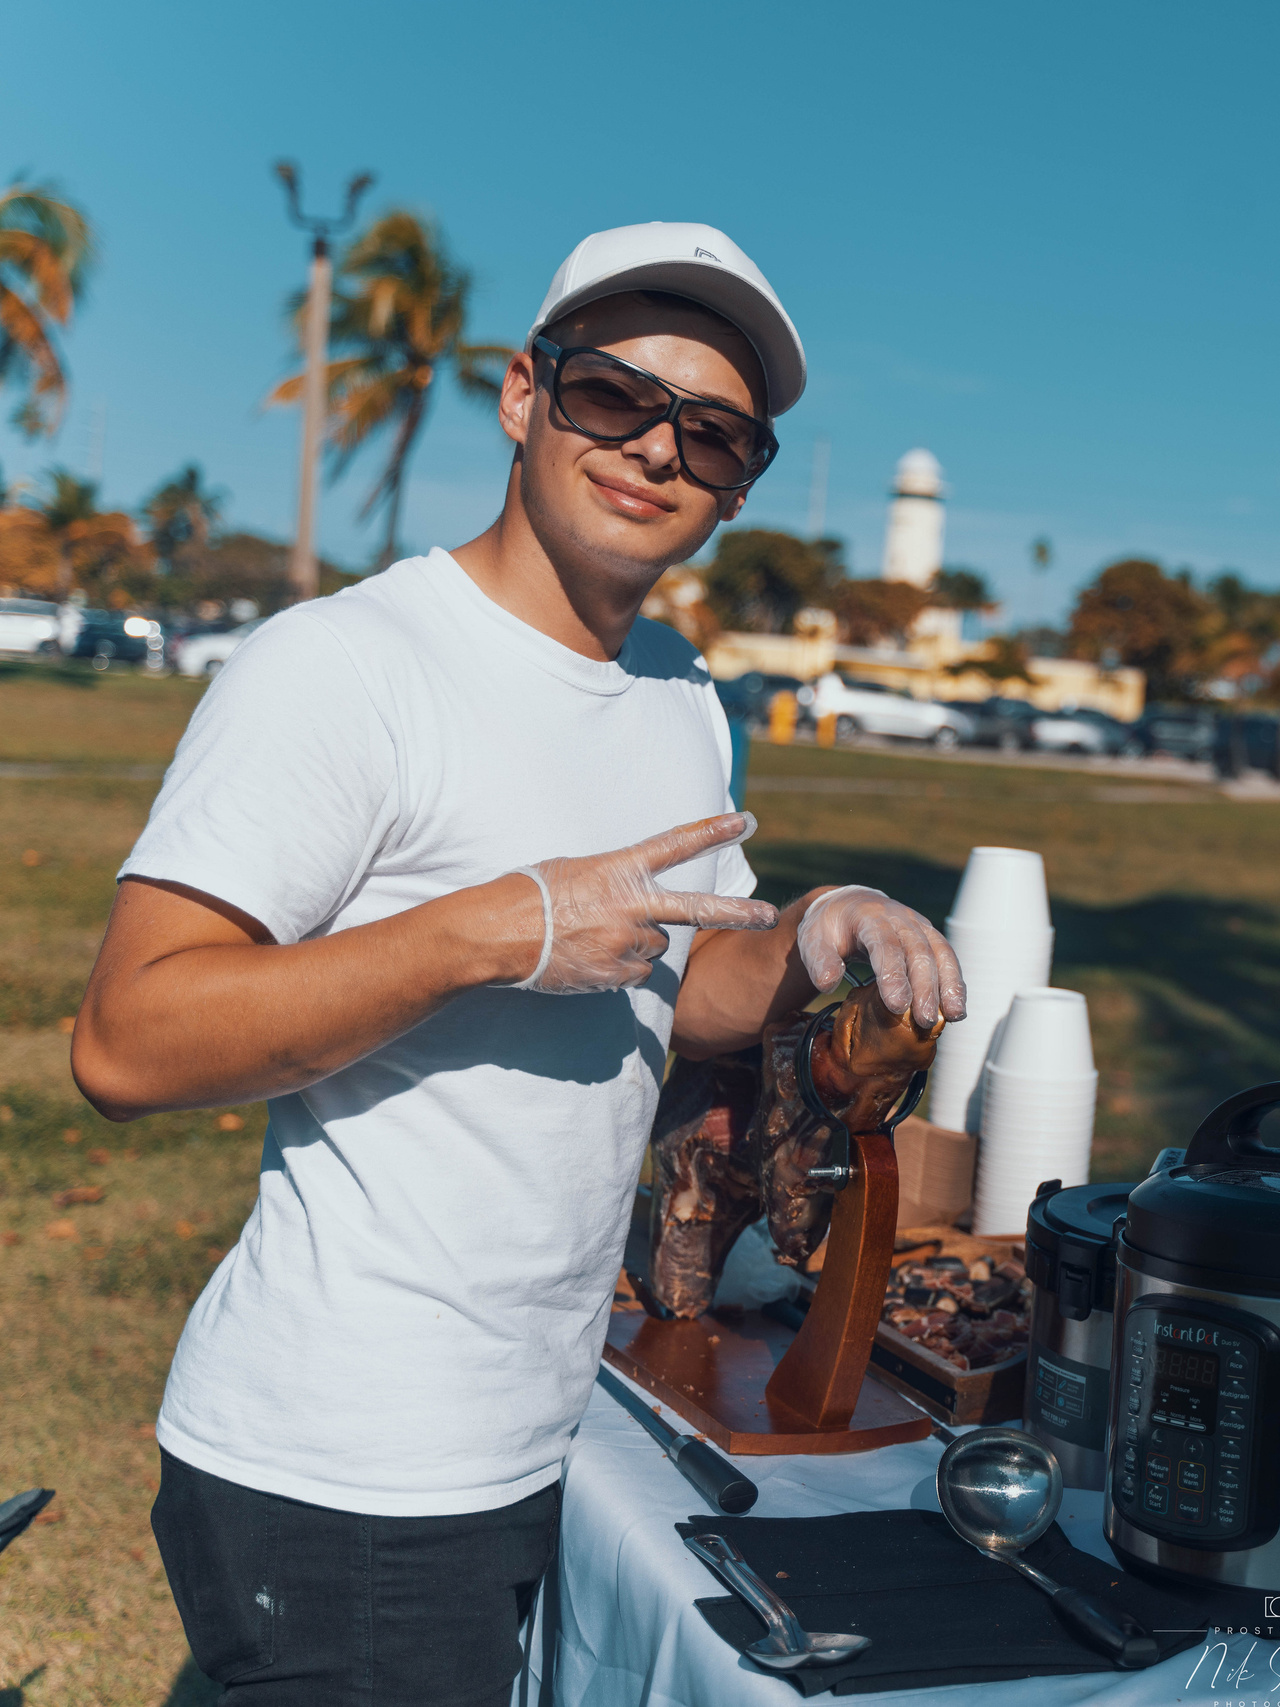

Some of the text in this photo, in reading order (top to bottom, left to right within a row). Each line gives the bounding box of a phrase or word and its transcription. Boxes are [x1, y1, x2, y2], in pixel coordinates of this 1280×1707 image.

[1153, 1319, 1193, 1342] Instant
[1196, 1328, 1218, 1346] Pot
[1170, 1384, 1190, 1393] Pressure
[1219, 1390, 1250, 1400] Multigrain
[1219, 1421, 1245, 1430] Porridge
[1147, 1462, 1169, 1472] Pressure
[1183, 1471, 1199, 1479] Keep
[1183, 1478, 1199, 1486] Warm
[1219, 1480, 1239, 1490] Yogurt
[1148, 1492, 1163, 1501] Delay
[1149, 1500, 1161, 1508] Start
[1179, 1503, 1199, 1513] Cancel
[1219, 1507, 1234, 1515] Sous
[1219, 1515, 1233, 1523] Vide
